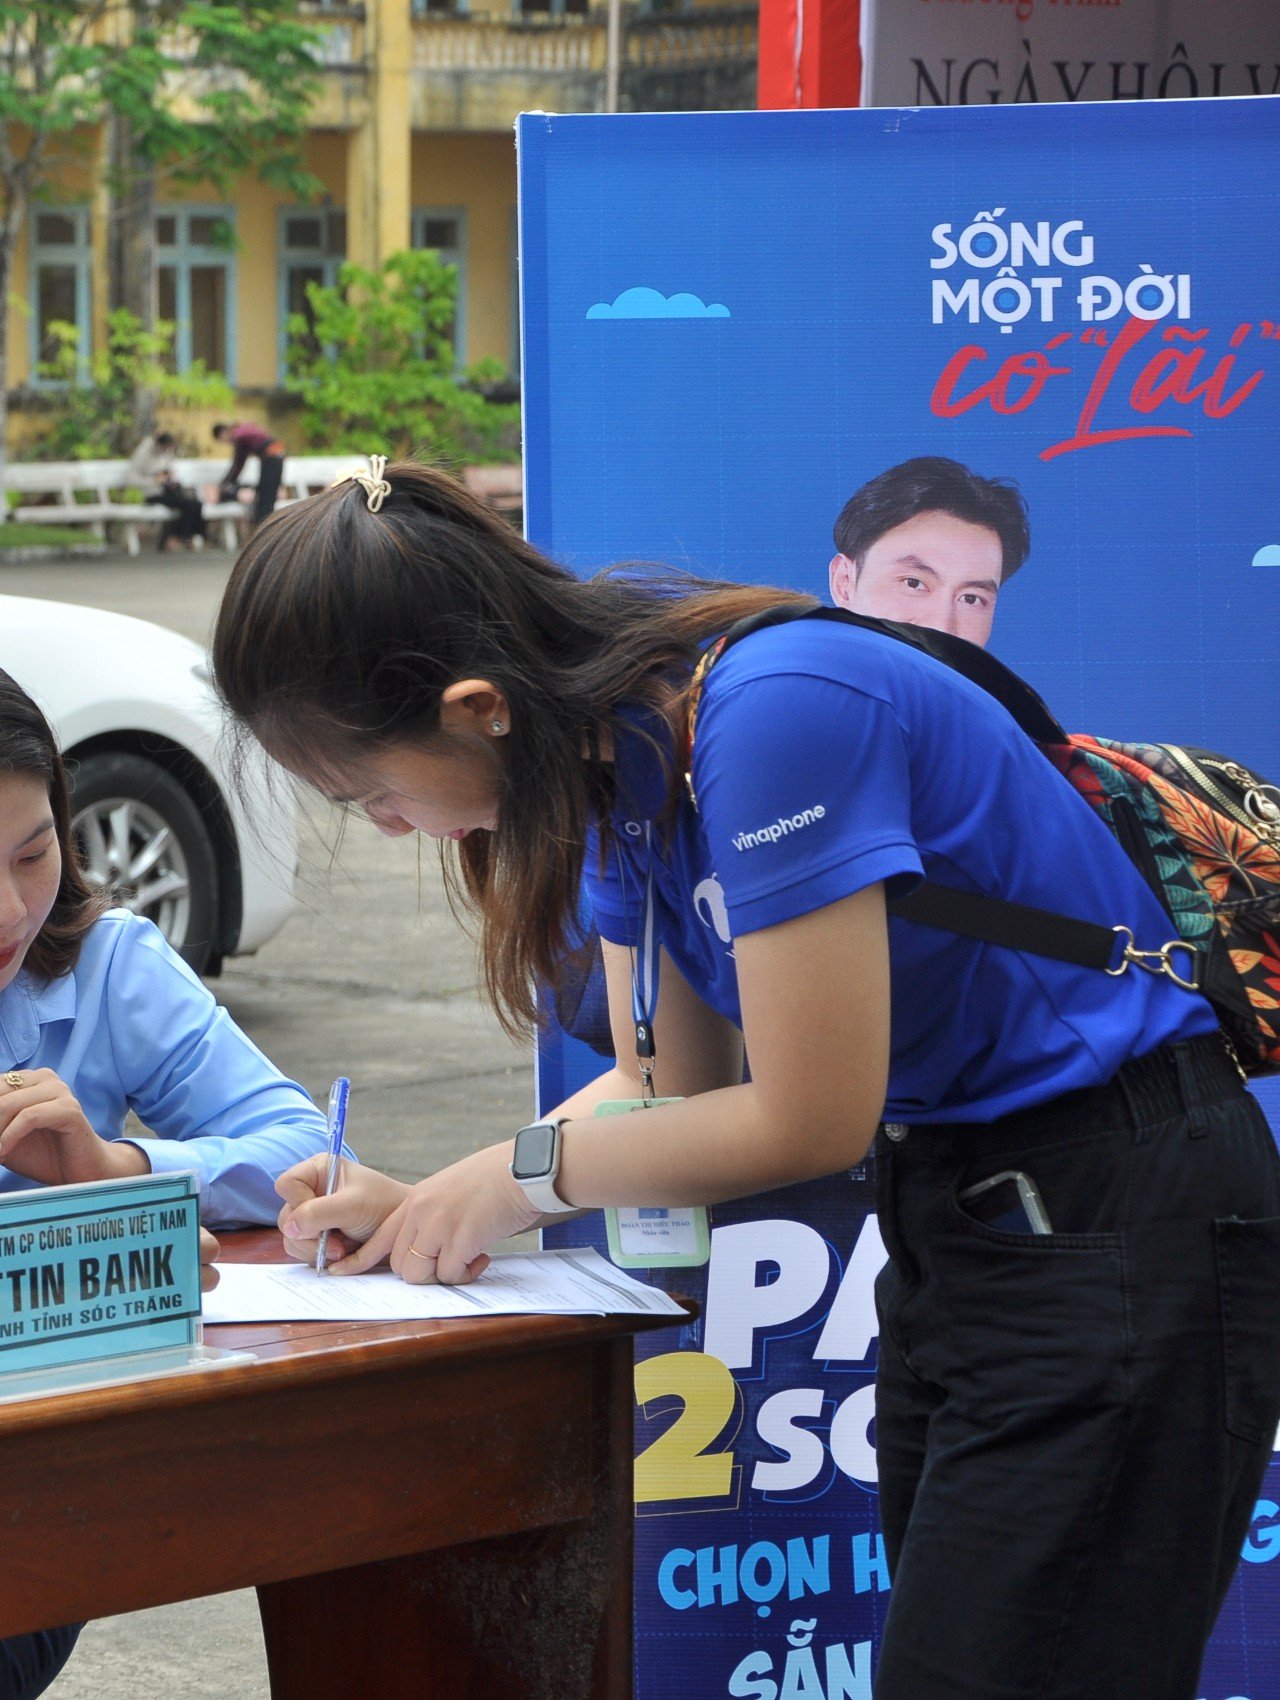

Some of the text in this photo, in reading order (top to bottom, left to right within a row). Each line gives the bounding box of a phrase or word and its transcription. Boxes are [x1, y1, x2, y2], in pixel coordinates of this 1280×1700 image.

[910, 38, 1095, 106] NGÀY
[930, 207, 1094, 269] SỐNG
[931, 264, 1191, 334] MỘT ĐỜI
[930, 332, 1071, 418] có
[732, 805, 826, 851] vinaphone
[19, 1232, 35, 1254] CP
[39, 1225, 73, 1251] CÔNG
[128, 1210, 156, 1239] VIỆT
[160, 1208, 187, 1231] NAM
[78, 1244, 175, 1301] BANK
[80, 1303, 117, 1325] SÓC
[123, 1293, 183, 1317] TRĂNG
[634, 1351, 735, 1503] 2
[658, 1534, 830, 1618] CHỌN
[728, 1617, 873, 1700] SẴN
